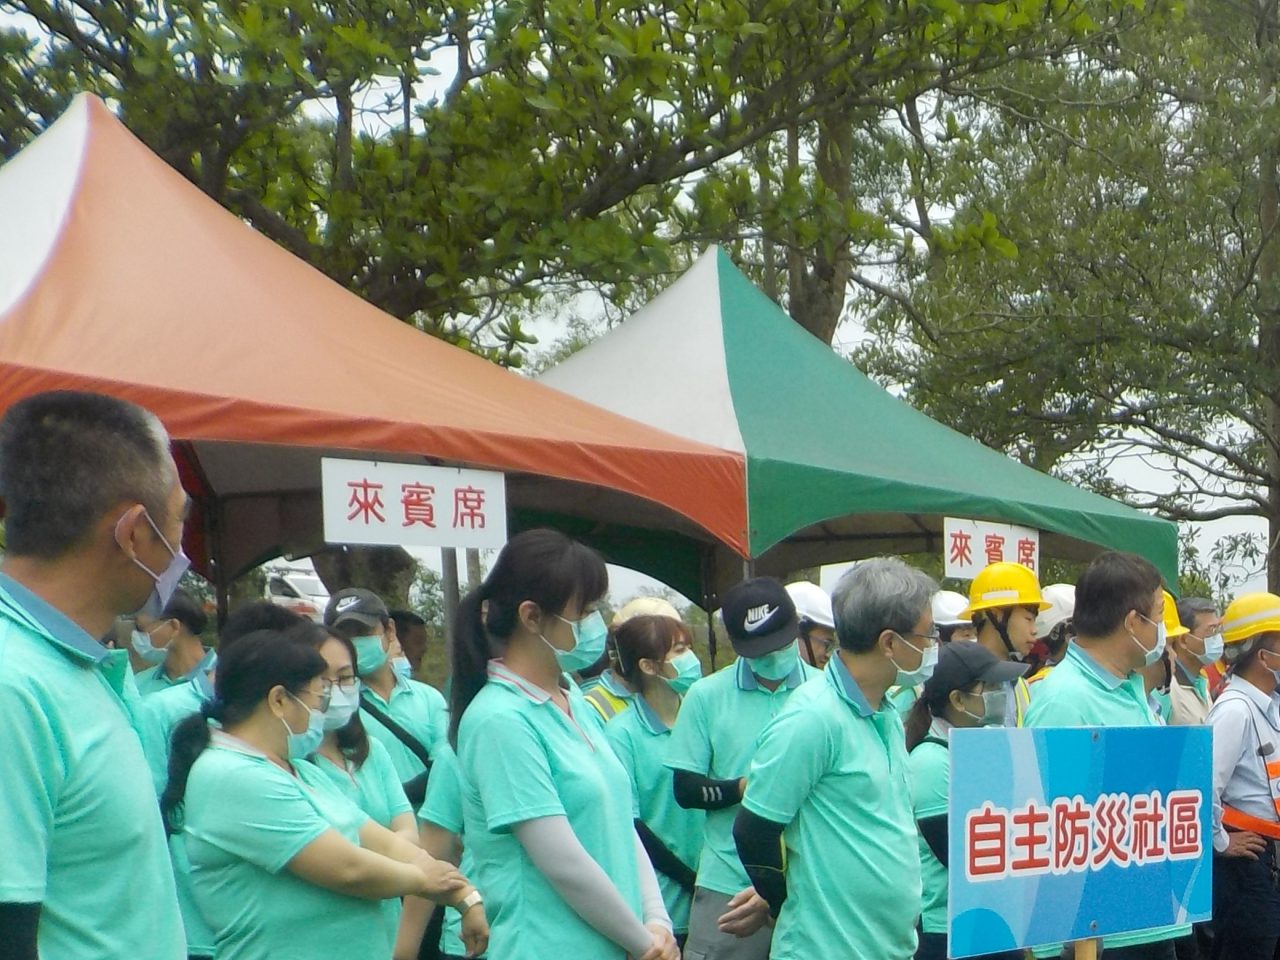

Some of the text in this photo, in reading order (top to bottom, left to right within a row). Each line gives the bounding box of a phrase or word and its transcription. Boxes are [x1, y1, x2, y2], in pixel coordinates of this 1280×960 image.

[347, 477, 486, 530] 來賓席
[949, 528, 1036, 570] 來賓席
[747, 603, 770, 622] NIKE
[967, 791, 1201, 879] 自主防災社區
